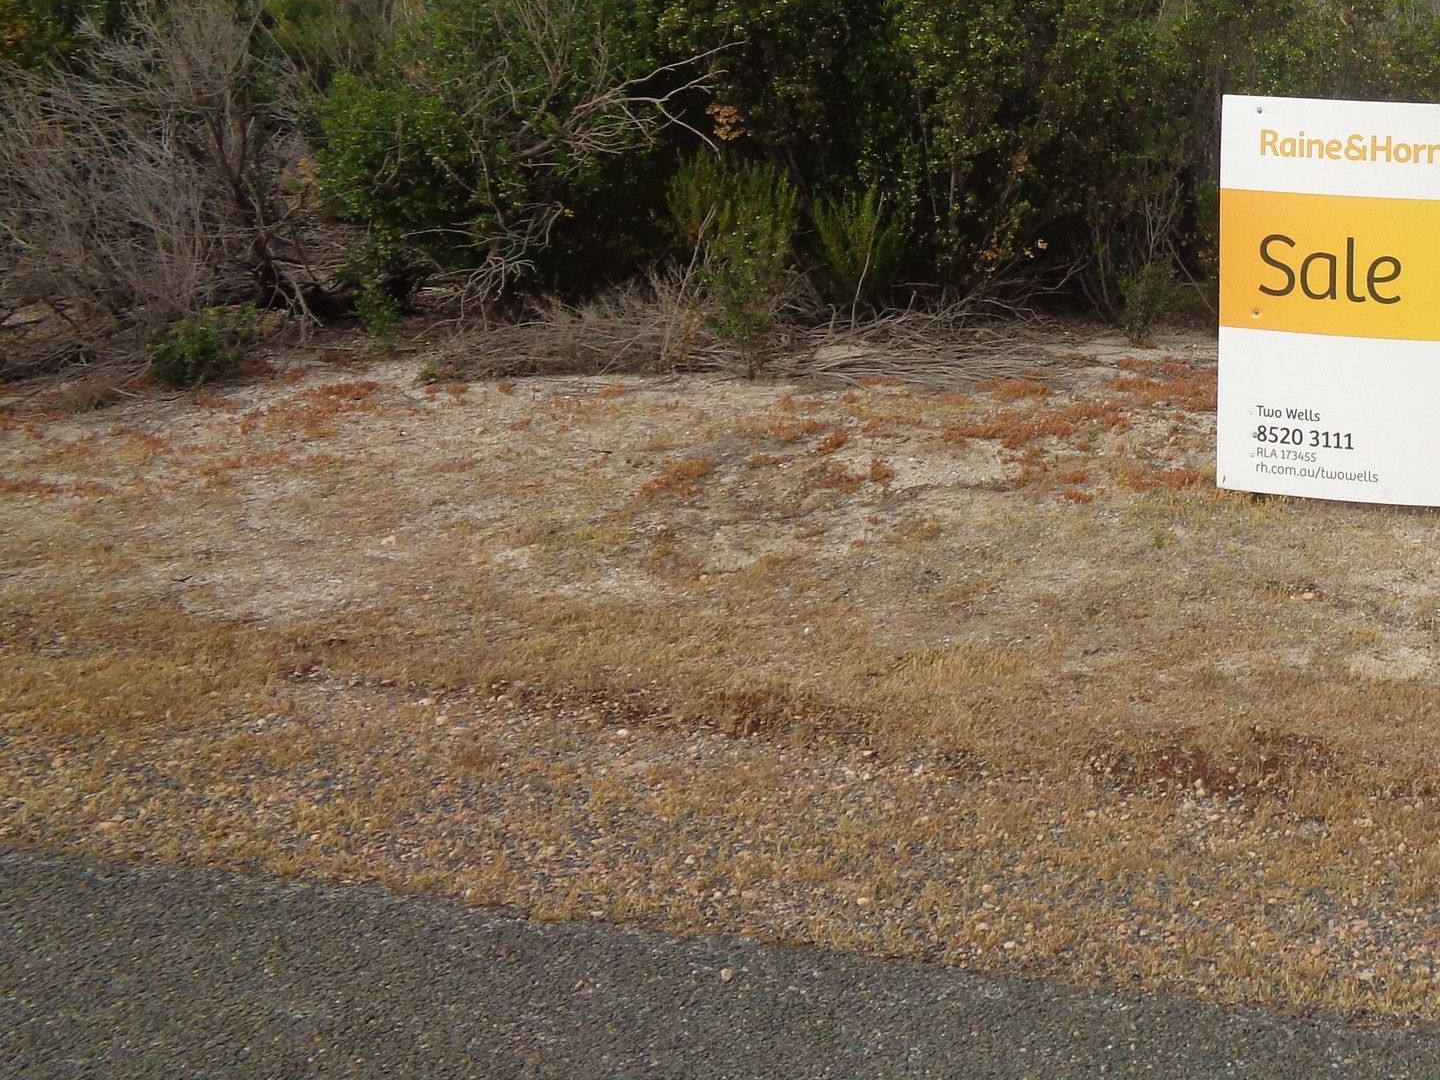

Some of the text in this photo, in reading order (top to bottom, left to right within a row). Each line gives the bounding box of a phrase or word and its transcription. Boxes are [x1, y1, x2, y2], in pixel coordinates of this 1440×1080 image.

[1258, 233, 1402, 305] Sale
[1256, 405, 1320, 422] Two Wells
[1257, 425, 1354, 450] 8520 3111
[1256, 447, 1317, 462] RLA 173455
[1256, 462, 1379, 483] rh.com.au/twowells
